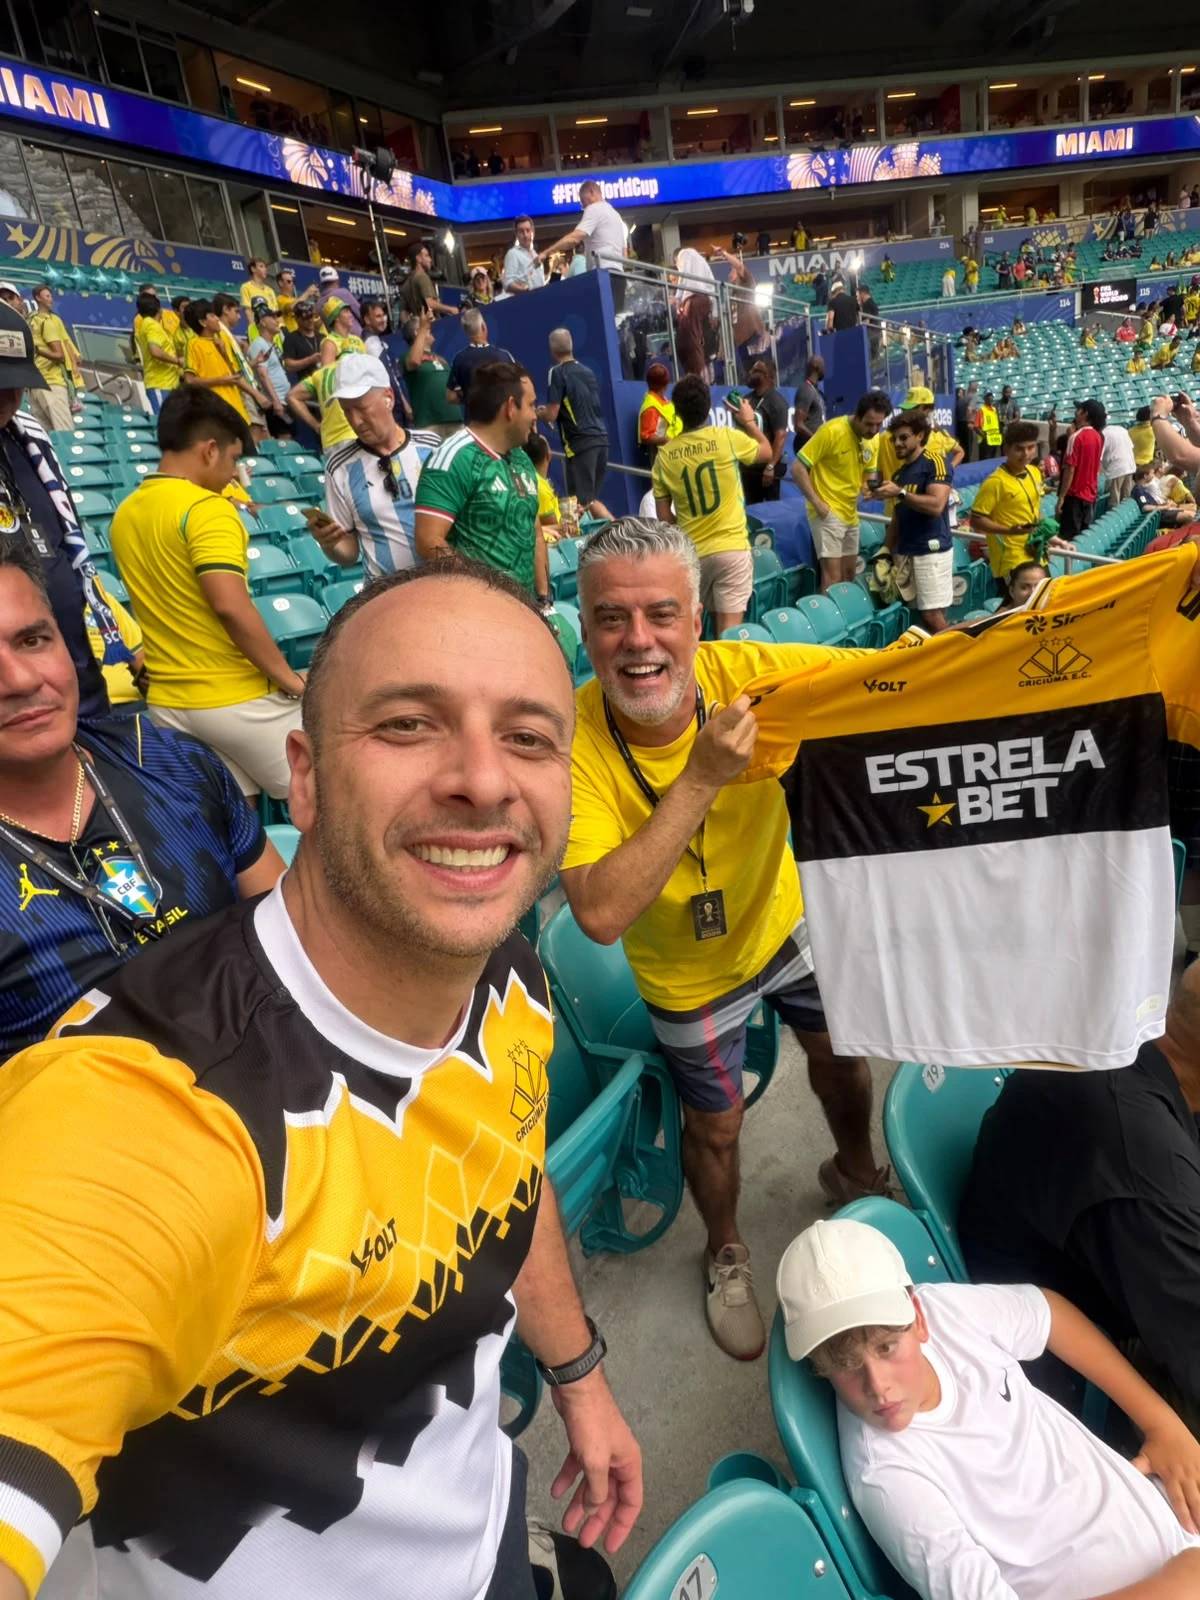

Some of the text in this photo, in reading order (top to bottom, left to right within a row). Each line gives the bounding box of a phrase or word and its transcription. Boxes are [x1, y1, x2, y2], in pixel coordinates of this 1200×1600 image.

[0, 66, 110, 129] IAMI
[1055, 126, 1134, 157] MIAMI
[551, 176, 659, 205] #FIWorldCup
[768, 248, 865, 277] MIAMI
[668, 444, 703, 460] NEYMAR
[680, 459, 721, 518] 10
[863, 679, 907, 693] VOLT
[865, 729, 1106, 794] ESTRELA
[957, 777, 1059, 826] BET
[117, 878, 137, 895] CBF
[136, 906, 188, 945] BASIL
[926, 1064, 939, 1085] 19
[350, 1217, 398, 1278] VOLT
